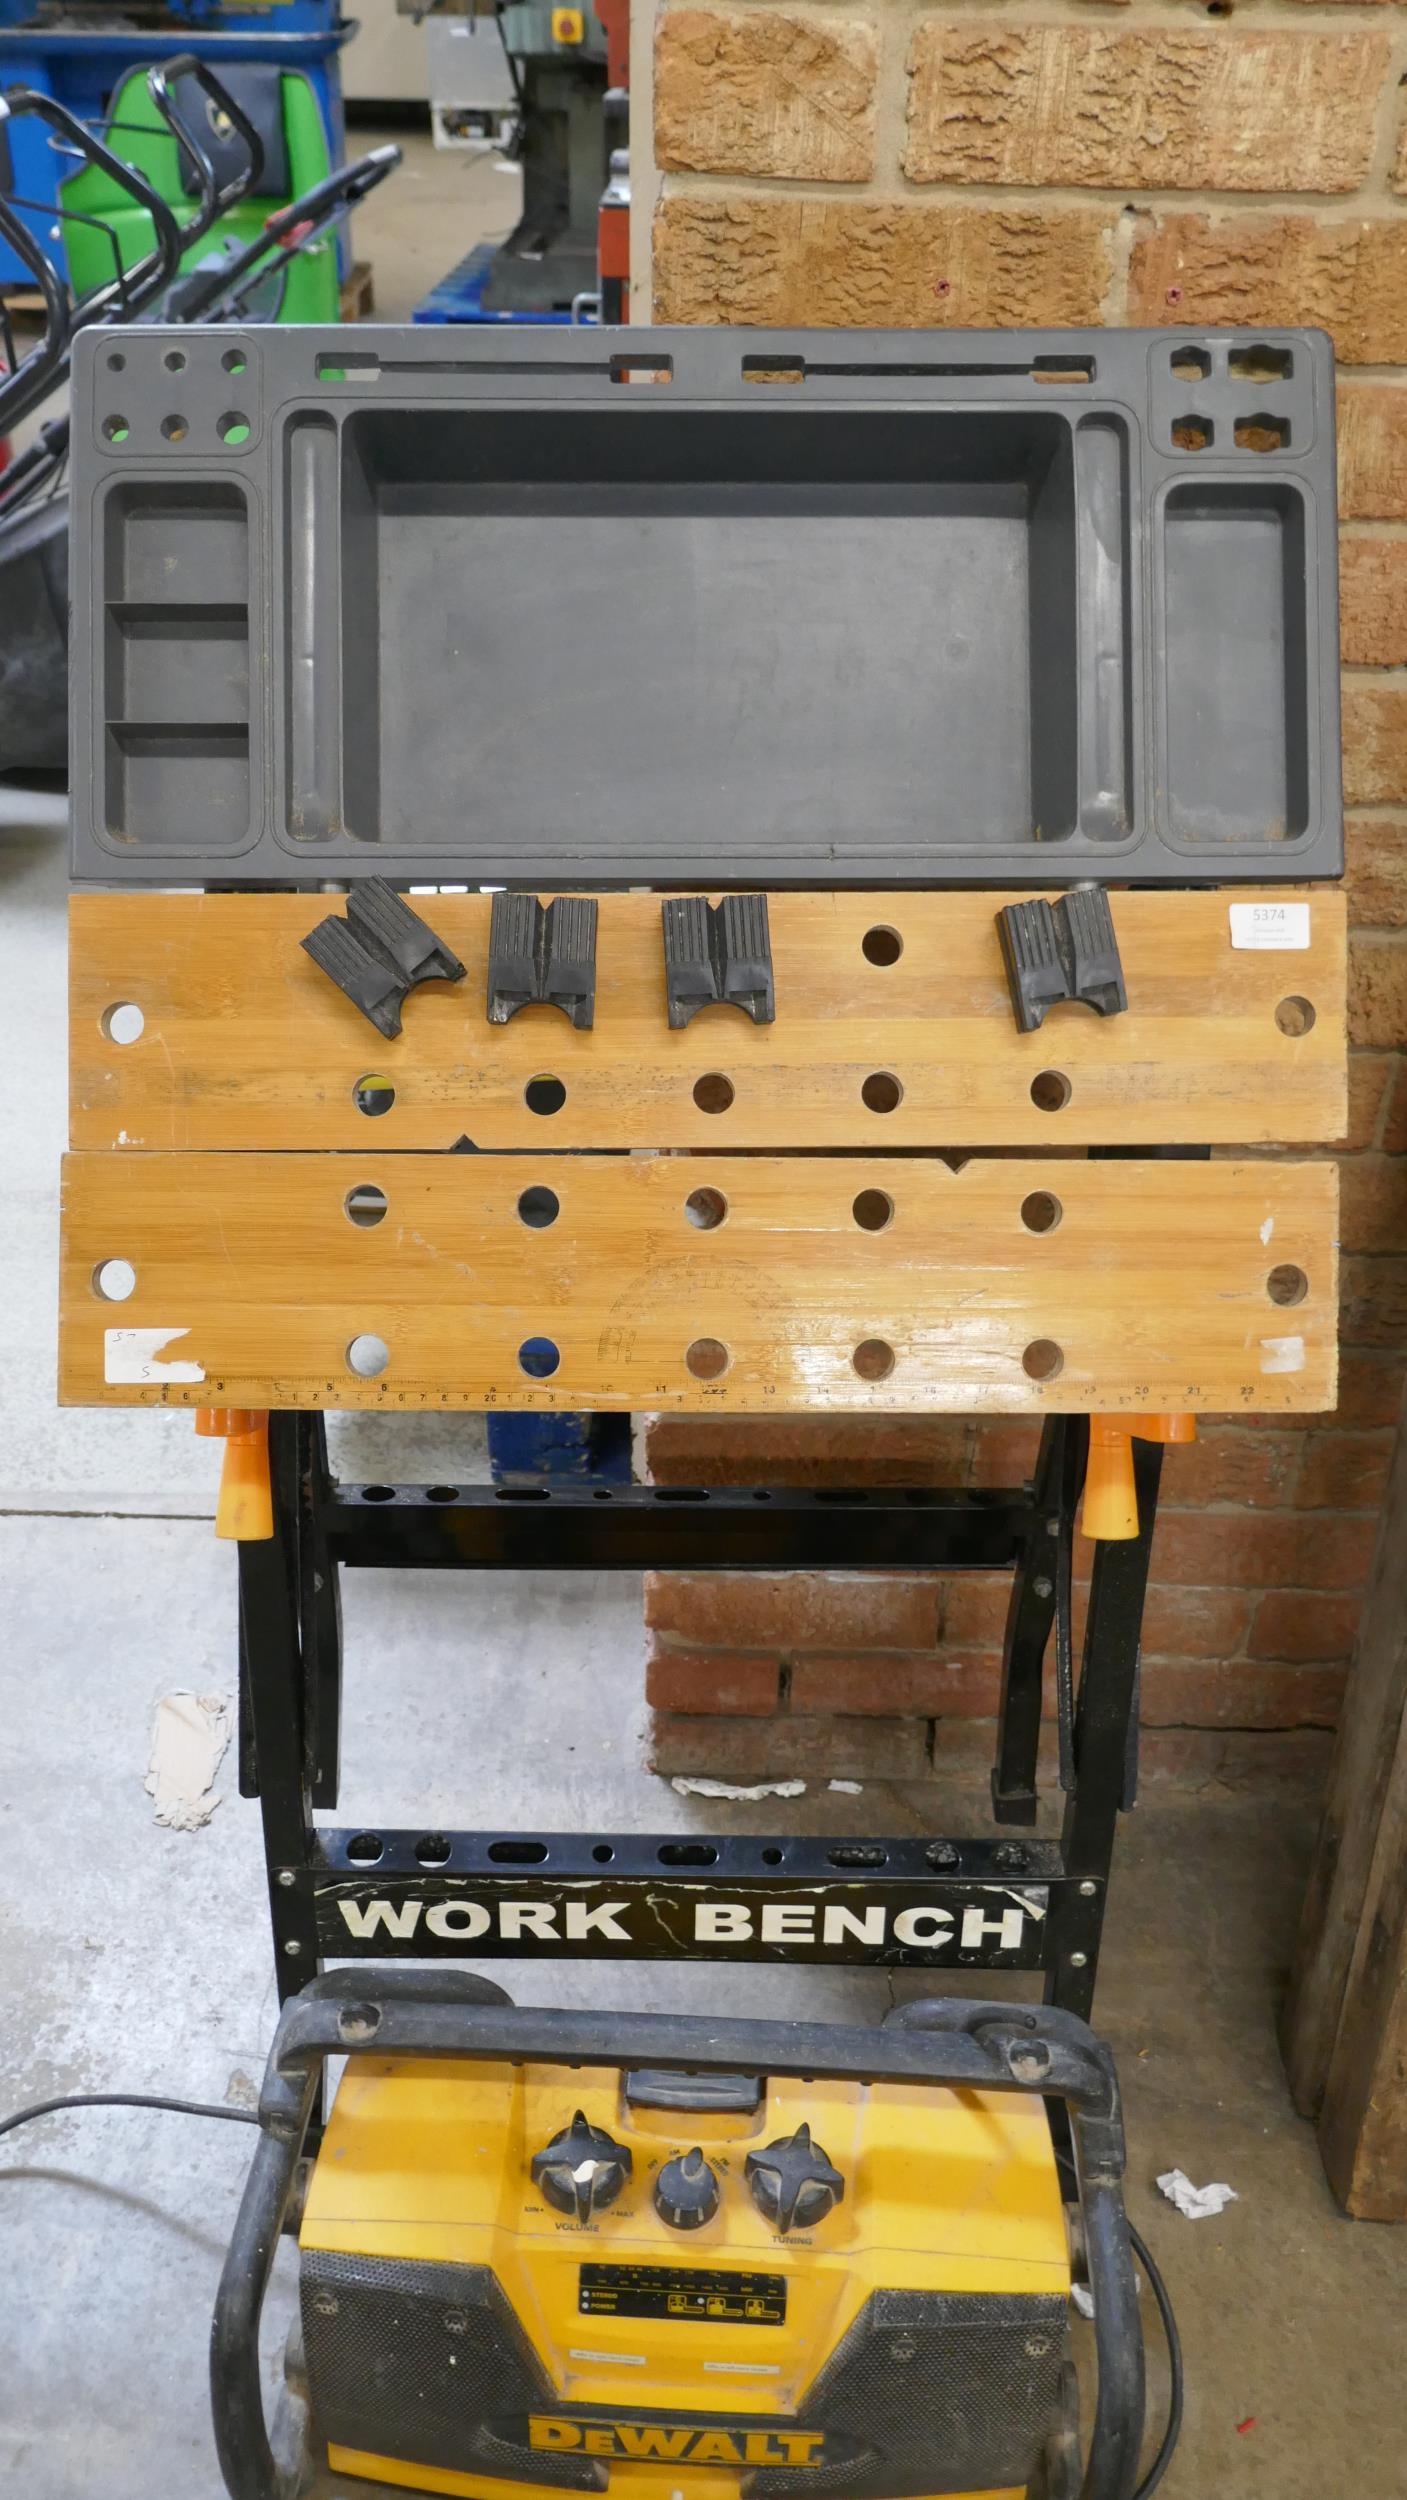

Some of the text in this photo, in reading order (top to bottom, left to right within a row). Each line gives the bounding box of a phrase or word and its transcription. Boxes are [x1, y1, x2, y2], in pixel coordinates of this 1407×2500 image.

[1253, 908, 1285, 921] 5374
[338, 1900, 1025, 1949] WORK BENCH
[555, 2222, 601, 2232] VOLUME
[771, 2235, 813, 2246] TUNING
[591, 2291, 618, 2299] STEREO
[530, 2417, 824, 2465] DEWALT
